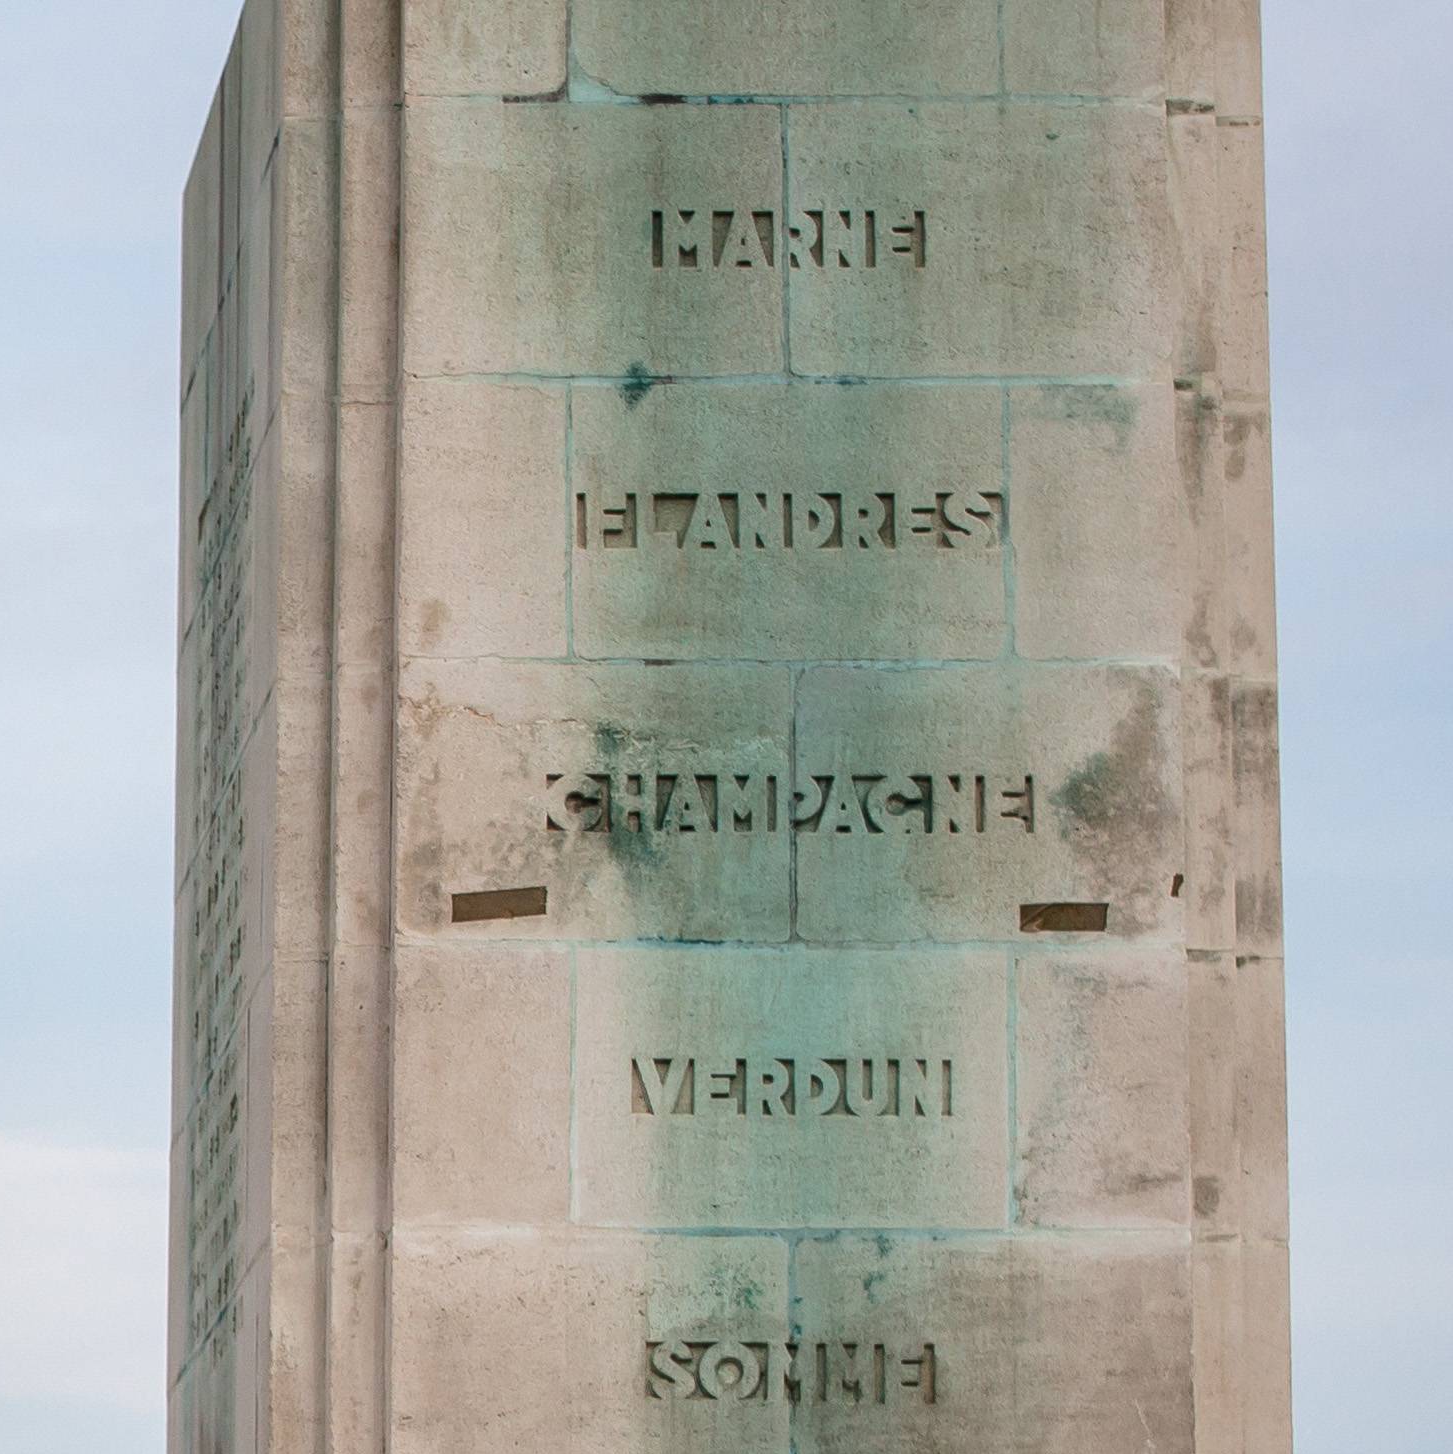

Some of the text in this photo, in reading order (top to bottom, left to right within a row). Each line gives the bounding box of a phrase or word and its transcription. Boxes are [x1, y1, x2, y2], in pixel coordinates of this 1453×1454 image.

[651, 208, 927, 268] MARNE
[575, 491, 1005, 550] FLANDRES
[545, 773, 1035, 833] CHAMPAGNE
[631, 1057, 953, 1117] VERDUN
[645, 1340, 938, 1402] SOMME
